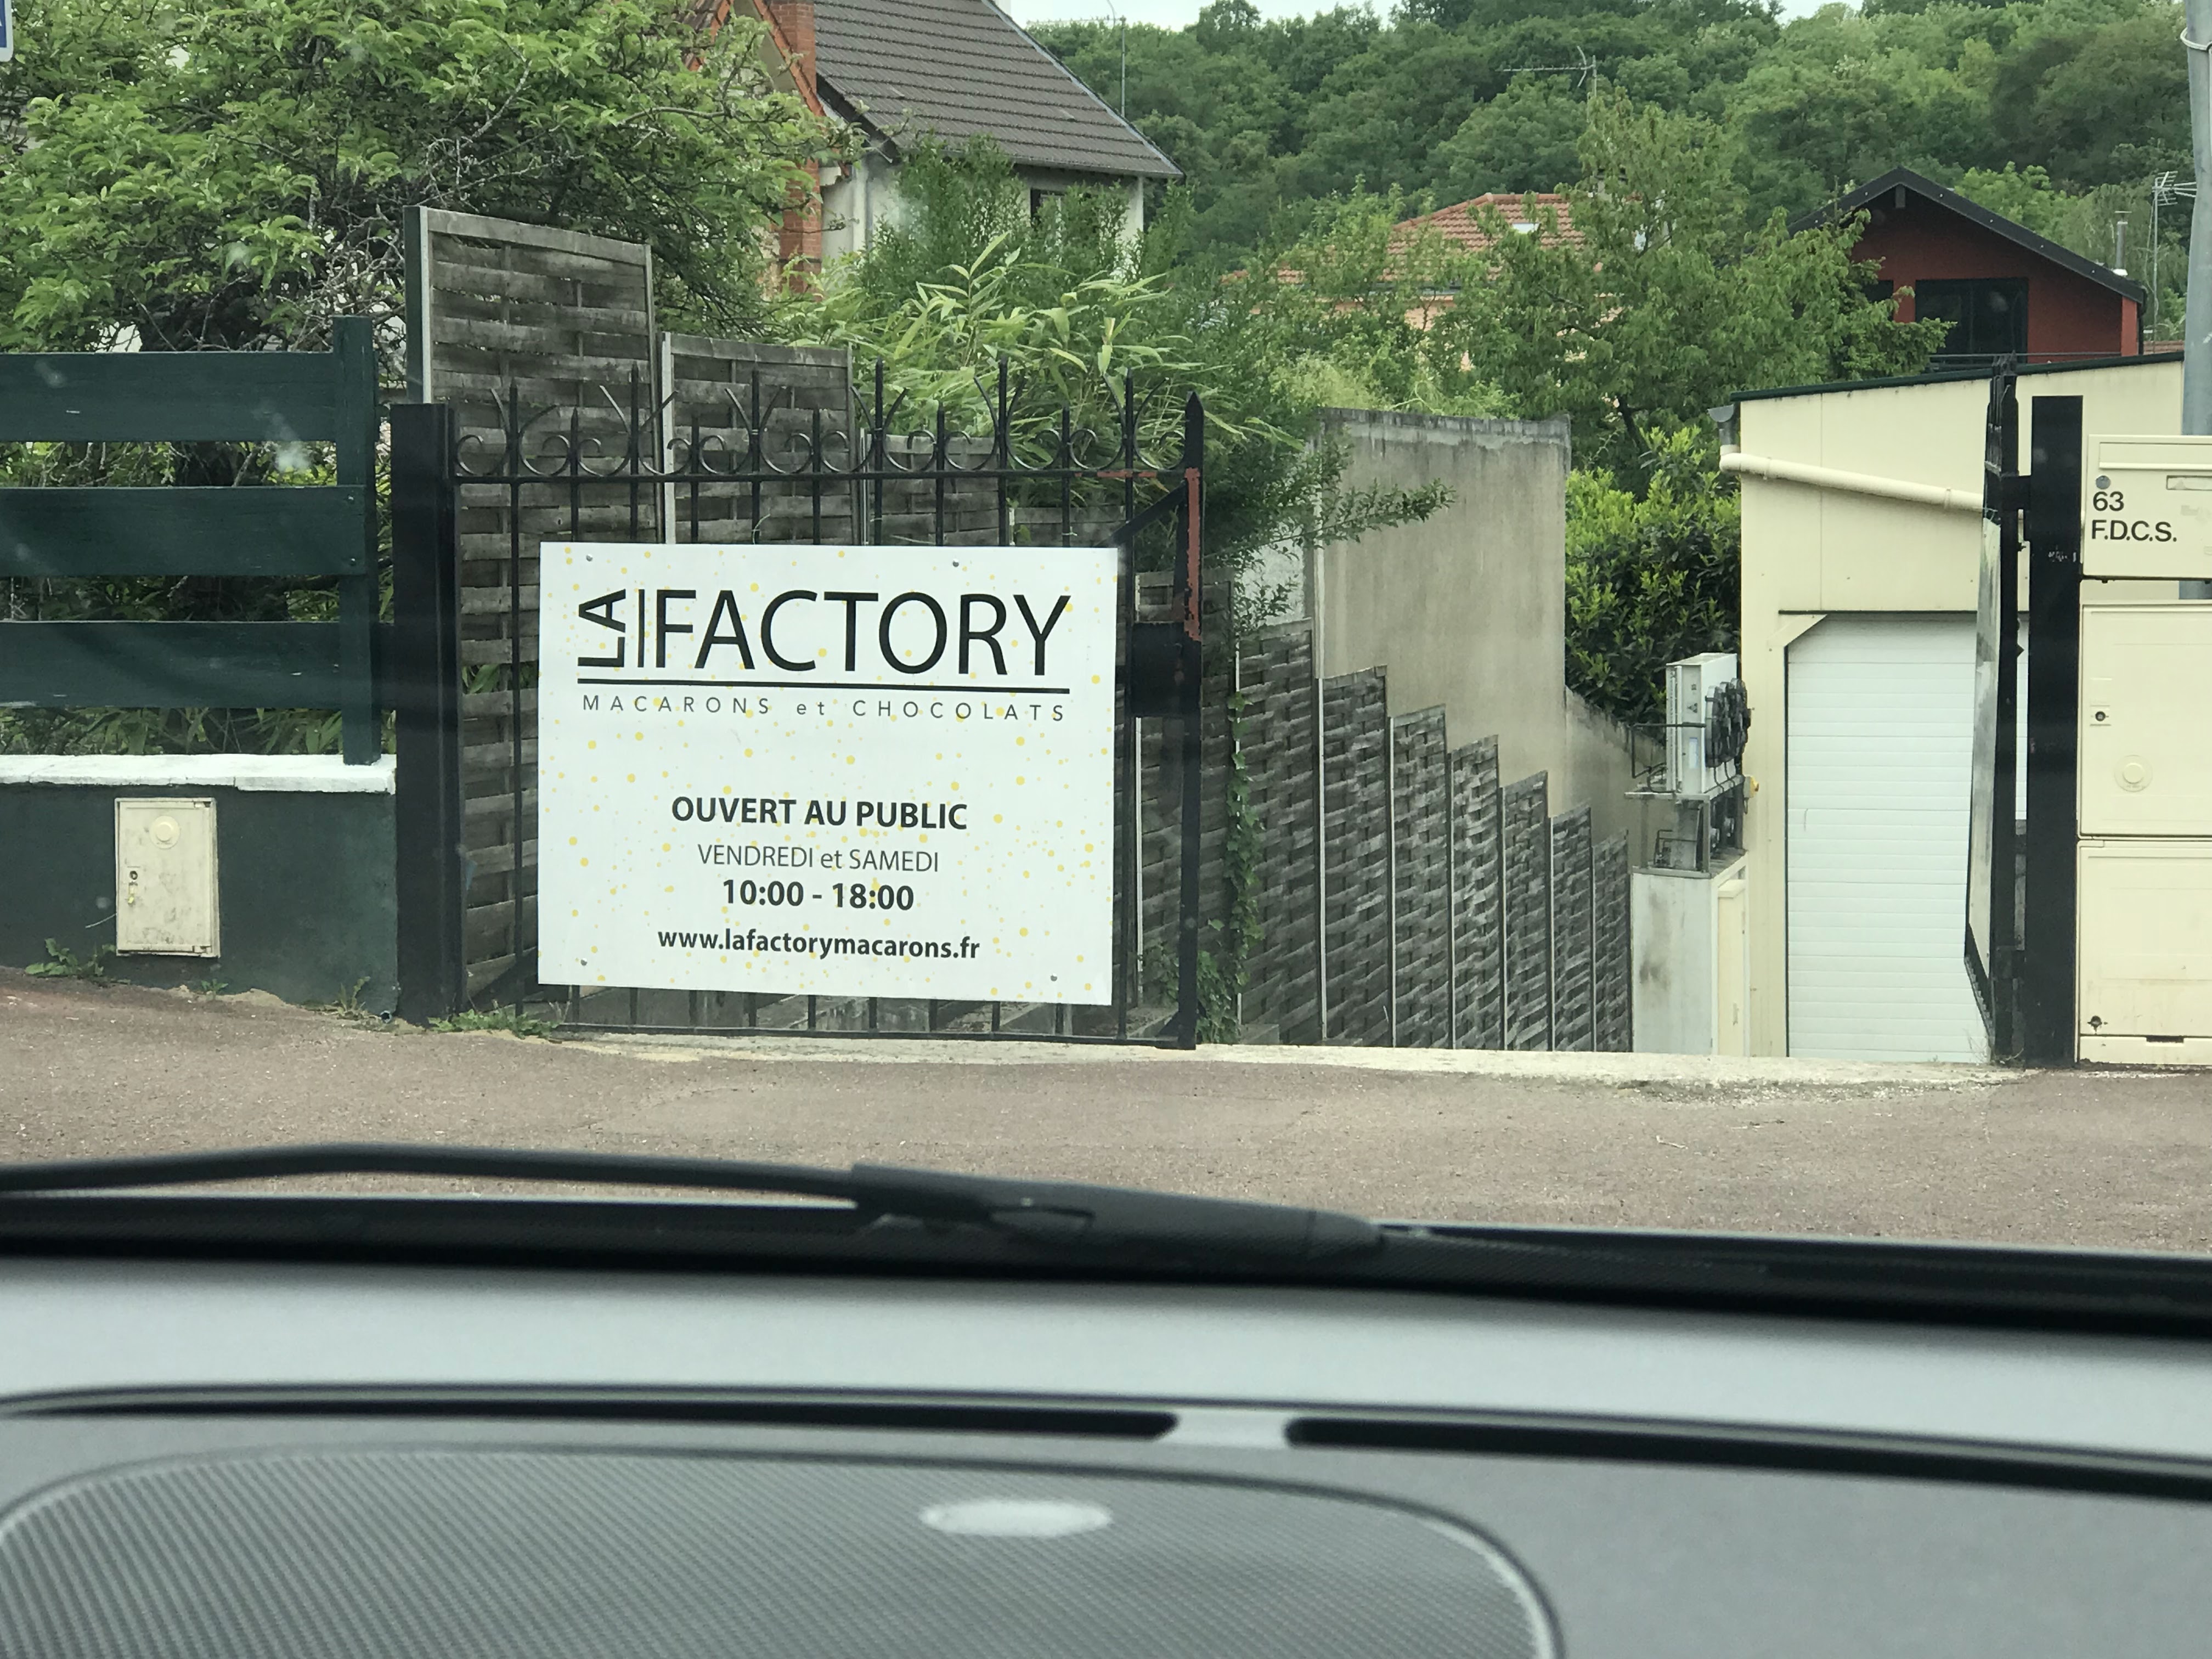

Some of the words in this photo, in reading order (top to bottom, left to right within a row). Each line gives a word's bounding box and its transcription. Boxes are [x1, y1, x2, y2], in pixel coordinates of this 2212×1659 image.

[2093, 491, 2124, 511] 63
[2091, 519, 2177, 542] F.D.C.S.
[577, 588, 627, 668] LA
[655, 589, 1071, 676] FACTORY
[583, 695, 769, 714] MACARONS
[797, 702, 825, 715] et
[853, 700, 1063, 721] CHOCOLATS
[672, 796, 797, 824] OUVERT
[804, 800, 846, 826] AU
[856, 801, 967, 830] PUBLIC
[697, 844, 812, 867] VENDREDI
[820, 850, 843, 869] et
[849, 849, 938, 872] SAMEDI
[723, 879, 804, 906] 10:00
[832, 883, 914, 911] 18:00
[658, 928, 980, 960] www.lafactorymacarons.fr
